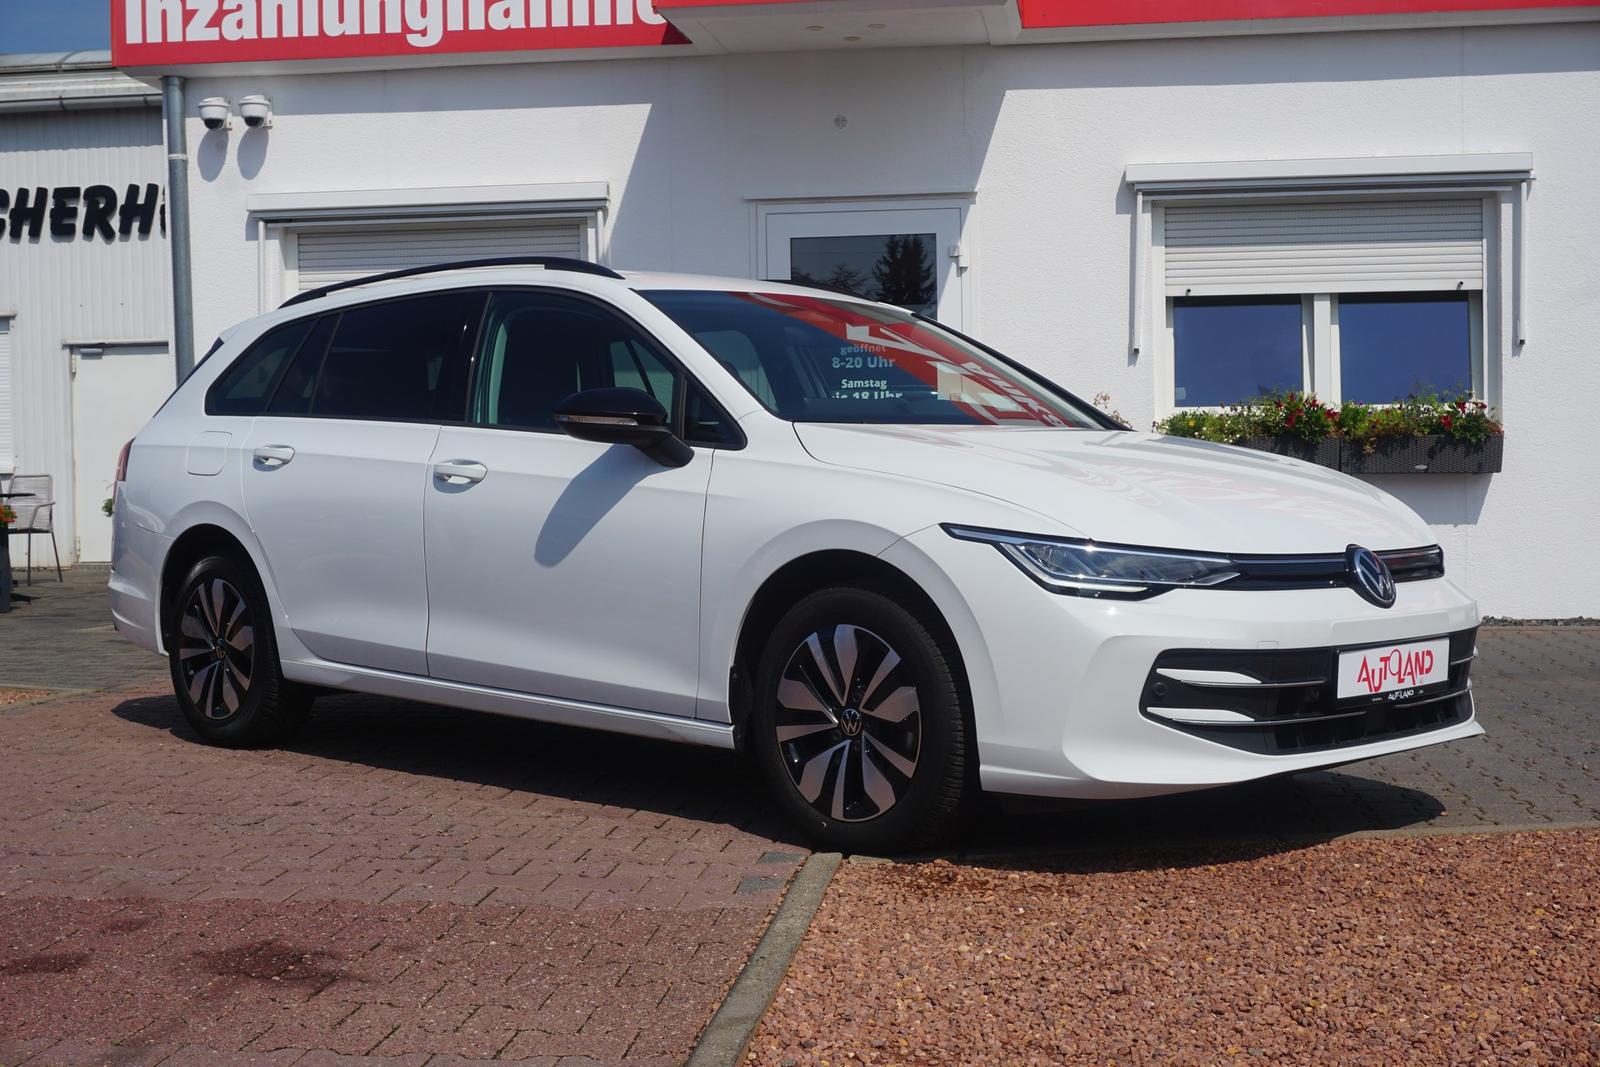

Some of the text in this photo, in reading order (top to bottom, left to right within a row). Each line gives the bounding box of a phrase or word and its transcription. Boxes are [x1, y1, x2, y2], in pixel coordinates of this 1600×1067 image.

[832, 356, 896, 369] 8-20 Uhr
[841, 379, 887, 389] Samstag
